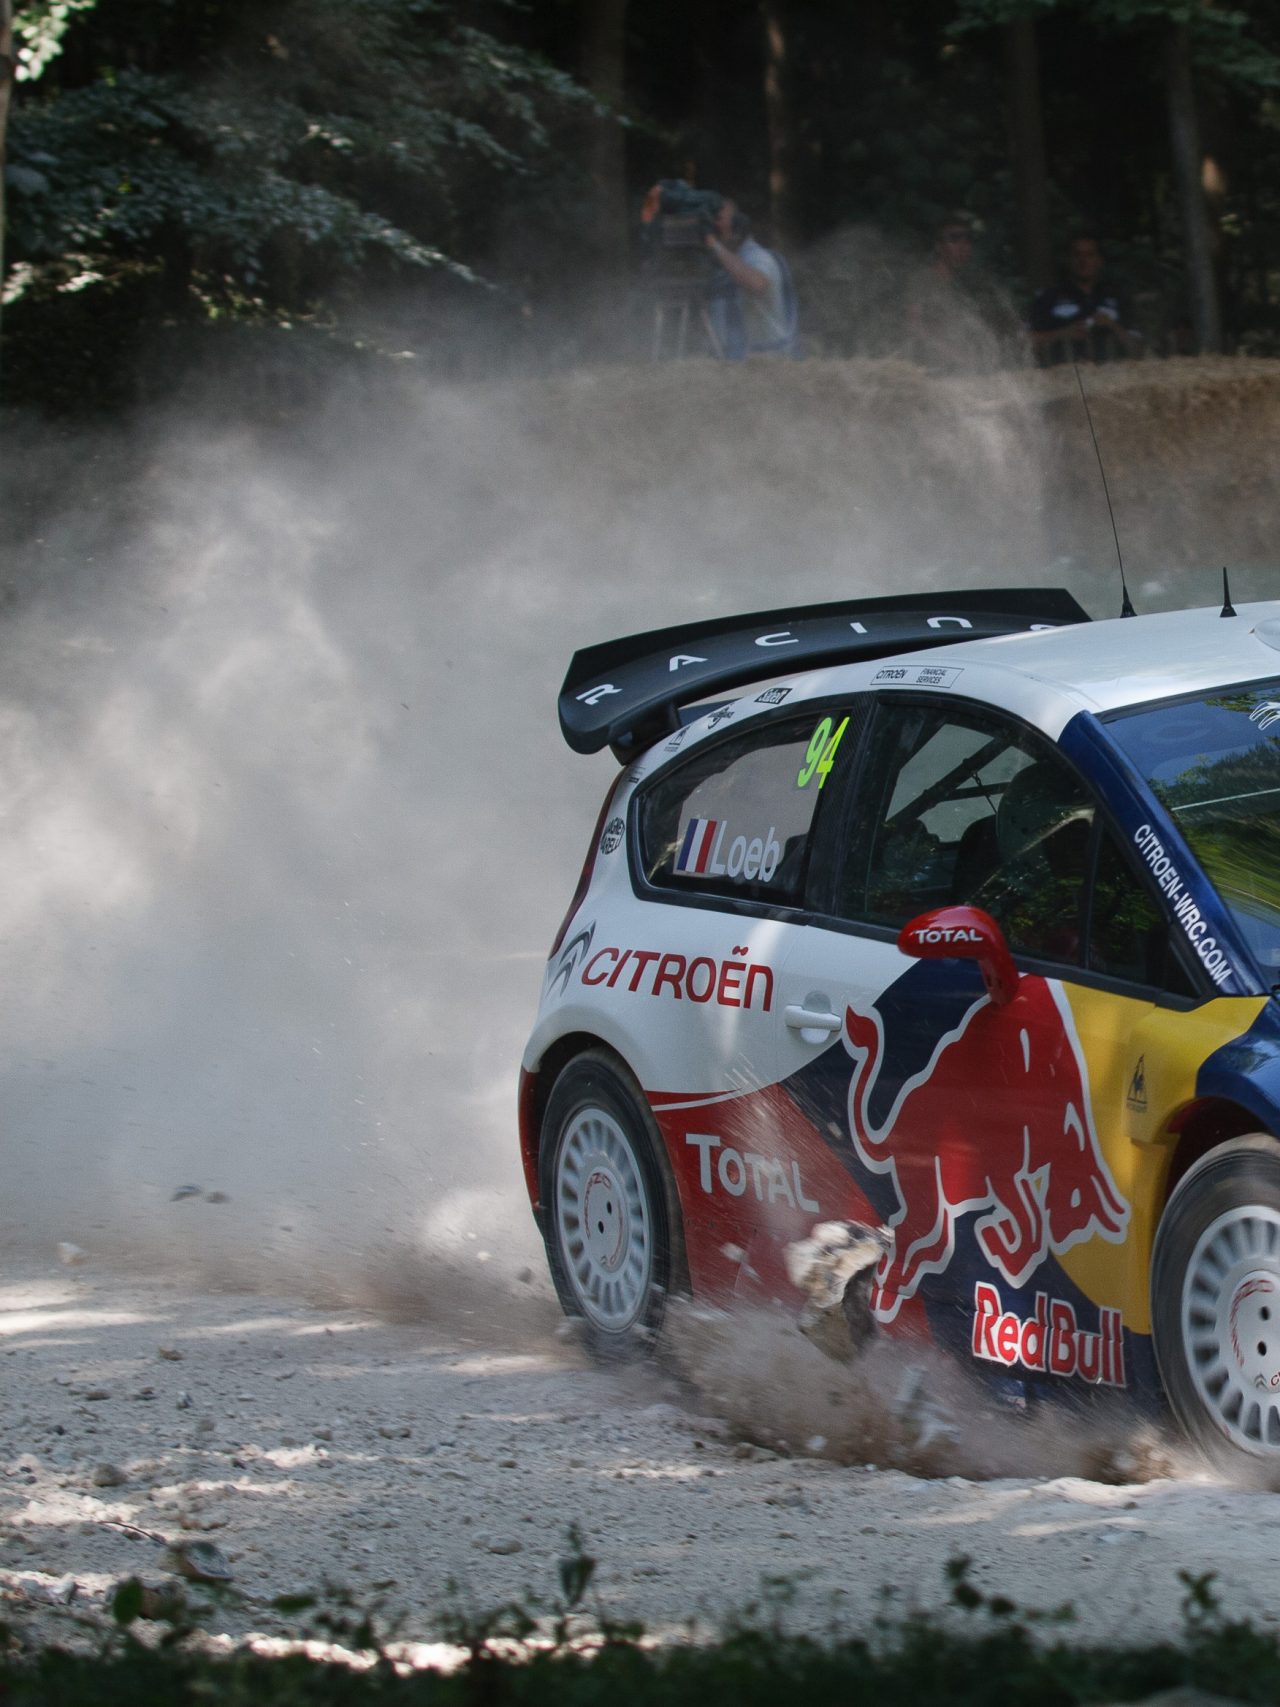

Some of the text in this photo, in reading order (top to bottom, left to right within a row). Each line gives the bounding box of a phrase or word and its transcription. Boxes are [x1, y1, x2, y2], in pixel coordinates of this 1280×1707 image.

[798, 717, 850, 788] 94
[710, 819, 781, 884] Loeb
[916, 929, 984, 943] TOTAL
[1134, 824, 1233, 986] CITROEN-WRC.COM
[581, 945, 774, 1012] CITROËN
[685, 1133, 820, 1214] TOTAL
